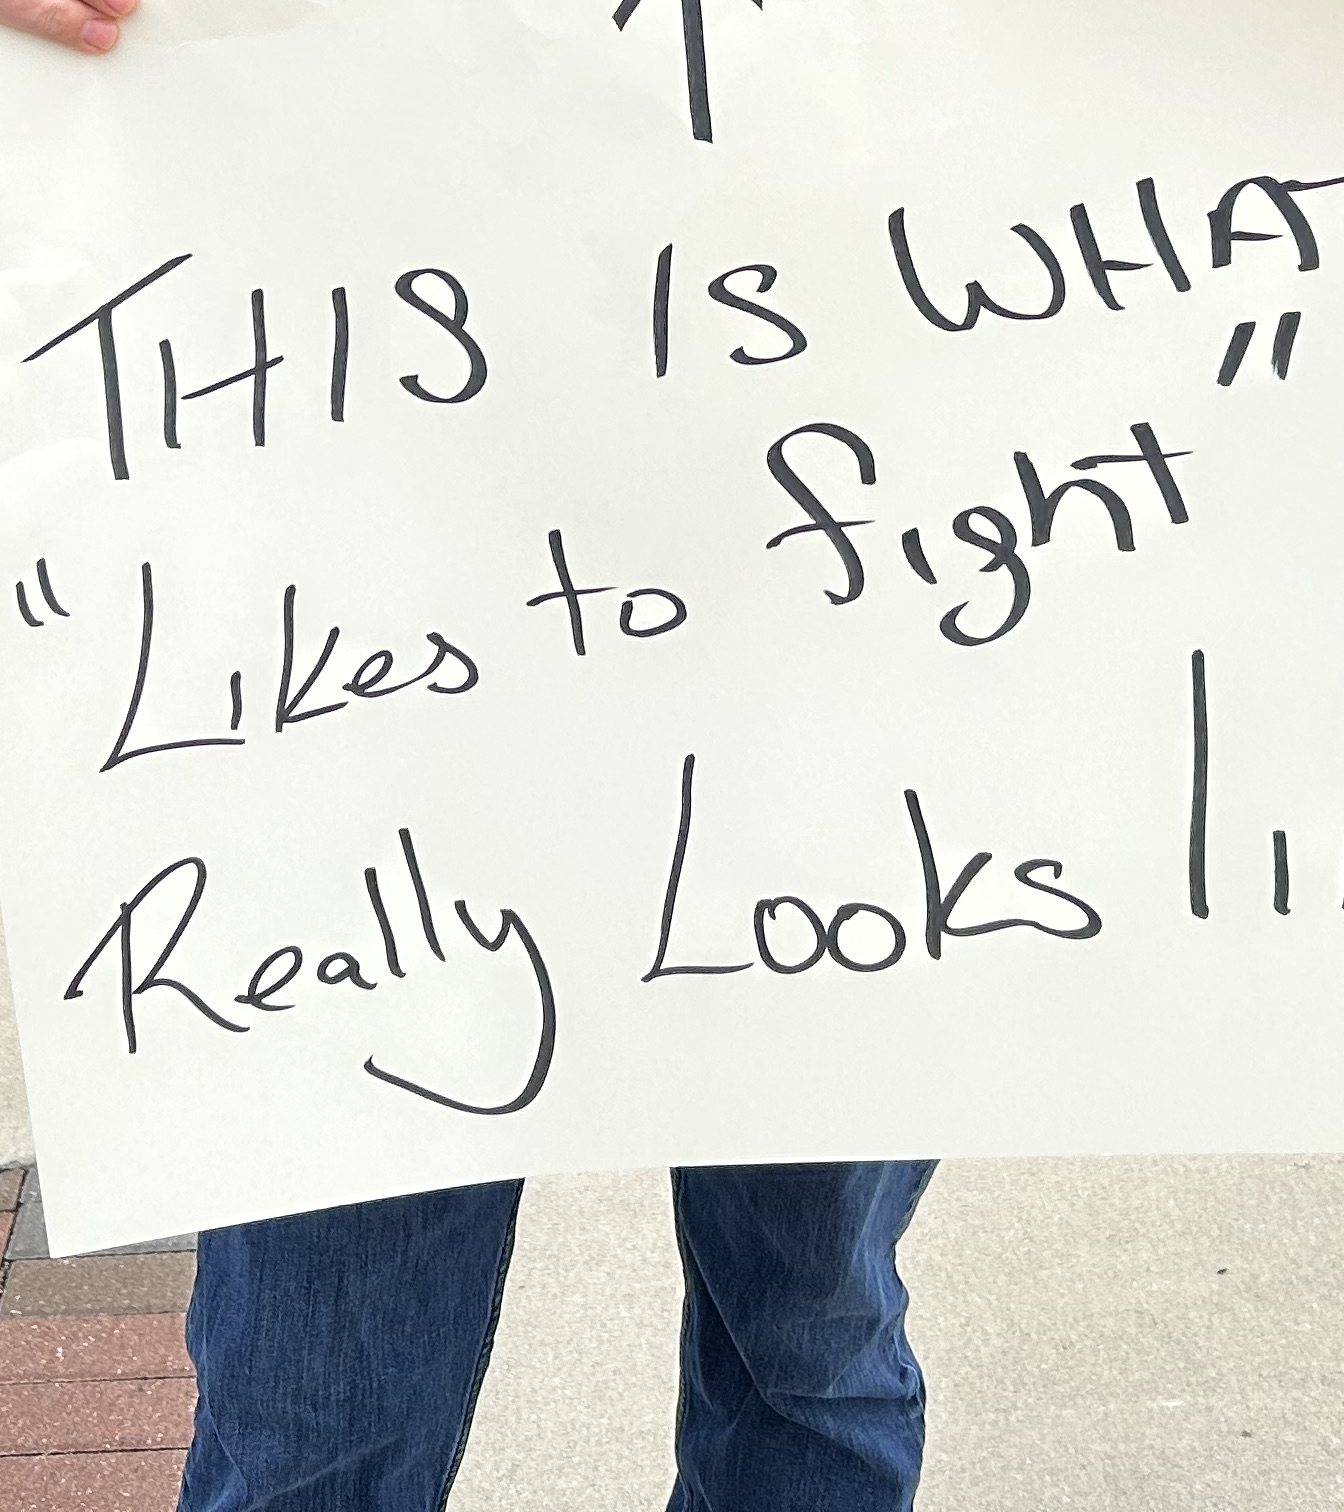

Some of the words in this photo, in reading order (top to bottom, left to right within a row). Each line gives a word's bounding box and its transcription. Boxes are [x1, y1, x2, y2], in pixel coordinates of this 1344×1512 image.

[22, 254, 489, 482] THIS
[653, 242, 809, 379] IS
[526, 529, 689, 657] to
[63, 827, 558, 1116] Really
